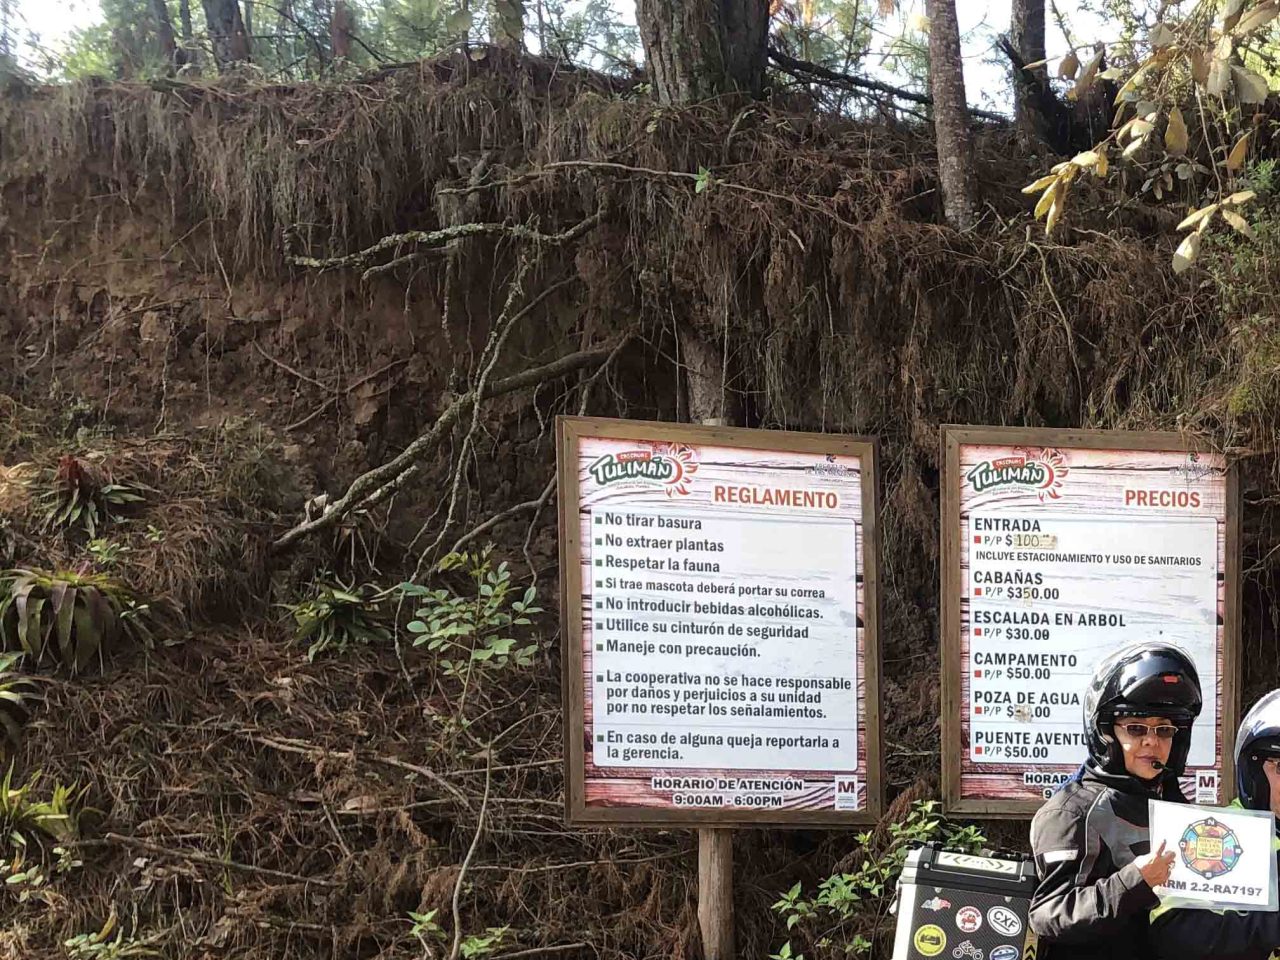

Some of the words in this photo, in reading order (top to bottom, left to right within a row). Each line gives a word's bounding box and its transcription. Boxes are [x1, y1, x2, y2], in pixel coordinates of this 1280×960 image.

[714, 485, 838, 509] REGLAMENTO
[1125, 490, 1200, 508] PRECIOS
[605, 512, 622, 526] No
[626, 513, 654, 526] tirar
[658, 515, 702, 530] basura
[974, 518, 1041, 532] ENTRADA
[605, 534, 622, 546] No
[626, 536, 672, 550] extraer
[676, 538, 724, 552] plantas
[984, 536, 1002, 546] P/P
[606, 555, 665, 571] Respetar
[668, 558, 680, 571] la
[684, 558, 720, 572] fauna
[976, 551, 1014, 560] INCLUYE
[1018, 552, 1103, 563] ESTACIONAMIENTO
[1113, 554, 1132, 564] USO
[1134, 556, 1146, 564] DE
[1148, 556, 1201, 566] SANITARIOS
[974, 569, 1043, 584] CABAÑAS
[605, 578, 616, 588] Si
[620, 579, 642, 590] trae
[646, 581, 694, 592] mascota
[697, 582, 735, 594] deberá
[738, 585, 772, 598] portar
[776, 587, 788, 598] su
[790, 588, 825, 599] correa
[986, 586, 1003, 597] P/P
[1007, 586, 1060, 600] $350.00
[606, 598, 624, 611] No
[626, 598, 691, 614] introducir
[694, 602, 744, 616] bebidas
[748, 602, 824, 619] alcohólicas.
[974, 611, 1050, 625] ESCALADA
[1055, 614, 1073, 626] EN
[1078, 614, 1126, 627] ARBOL
[606, 618, 649, 633] Utilice
[652, 622, 666, 633] su
[670, 620, 724, 636] cinturón
[728, 622, 743, 636] de
[746, 624, 808, 640] seguridad
[984, 628, 1002, 638] P/P
[1006, 627, 1050, 640] $30.00
[606, 640, 656, 656] Maneje
[658, 643, 682, 655] con
[686, 642, 761, 660] precaución.
[974, 652, 1077, 667] CAMPAMENTO
[984, 670, 1002, 680] P/P
[1006, 667, 1050, 680] $50.00
[607, 670, 622, 683] La
[625, 671, 701, 688] cooperativa
[704, 676, 720, 686] no
[723, 676, 738, 687] se
[742, 674, 772, 688] hace
[776, 676, 851, 694] responsable
[607, 687, 628, 702] por
[631, 684, 670, 700] daños
[674, 690, 680, 702] y
[684, 688, 746, 704] perjuicios
[750, 692, 757, 702] a
[760, 692, 775, 703] su
[778, 690, 822, 704] unidad
[974, 691, 1012, 704] POZA
[1018, 692, 1036, 704] DE
[1040, 692, 1080, 705] AGUA
[607, 702, 628, 716] por
[631, 702, 647, 714] no
[650, 703, 706, 719] respetar
[708, 703, 727, 716] los
[730, 704, 827, 719] señalamientos.
[984, 706, 1002, 716] P/P
[1006, 706, 1050, 718] $.00
[608, 731, 624, 744] En
[626, 734, 658, 745] caso
[660, 733, 676, 746] de
[680, 732, 723, 749] alguna
[727, 735, 762, 750] queja
[766, 736, 828, 750] reportarla
[832, 738, 840, 748] a
[976, 732, 1030, 744] PUENTE
[608, 746, 618, 758] la
[623, 748, 684, 762] gerencia.
[984, 746, 1002, 756] P/P
[1004, 746, 1048, 758] $50.00
[653, 778, 714, 790] HORARIO
[719, 779, 736, 790] DE
[740, 778, 803, 791] ATENCIÓN
[838, 781, 854, 793] M
[1199, 776, 1215, 788] M
[674, 795, 723, 806] 9:00AM
[734, 796, 782, 806] 6:00PM
[1190, 882, 1262, 896] 2.2-RA7197
[994, 910, 1018, 928] CXF
